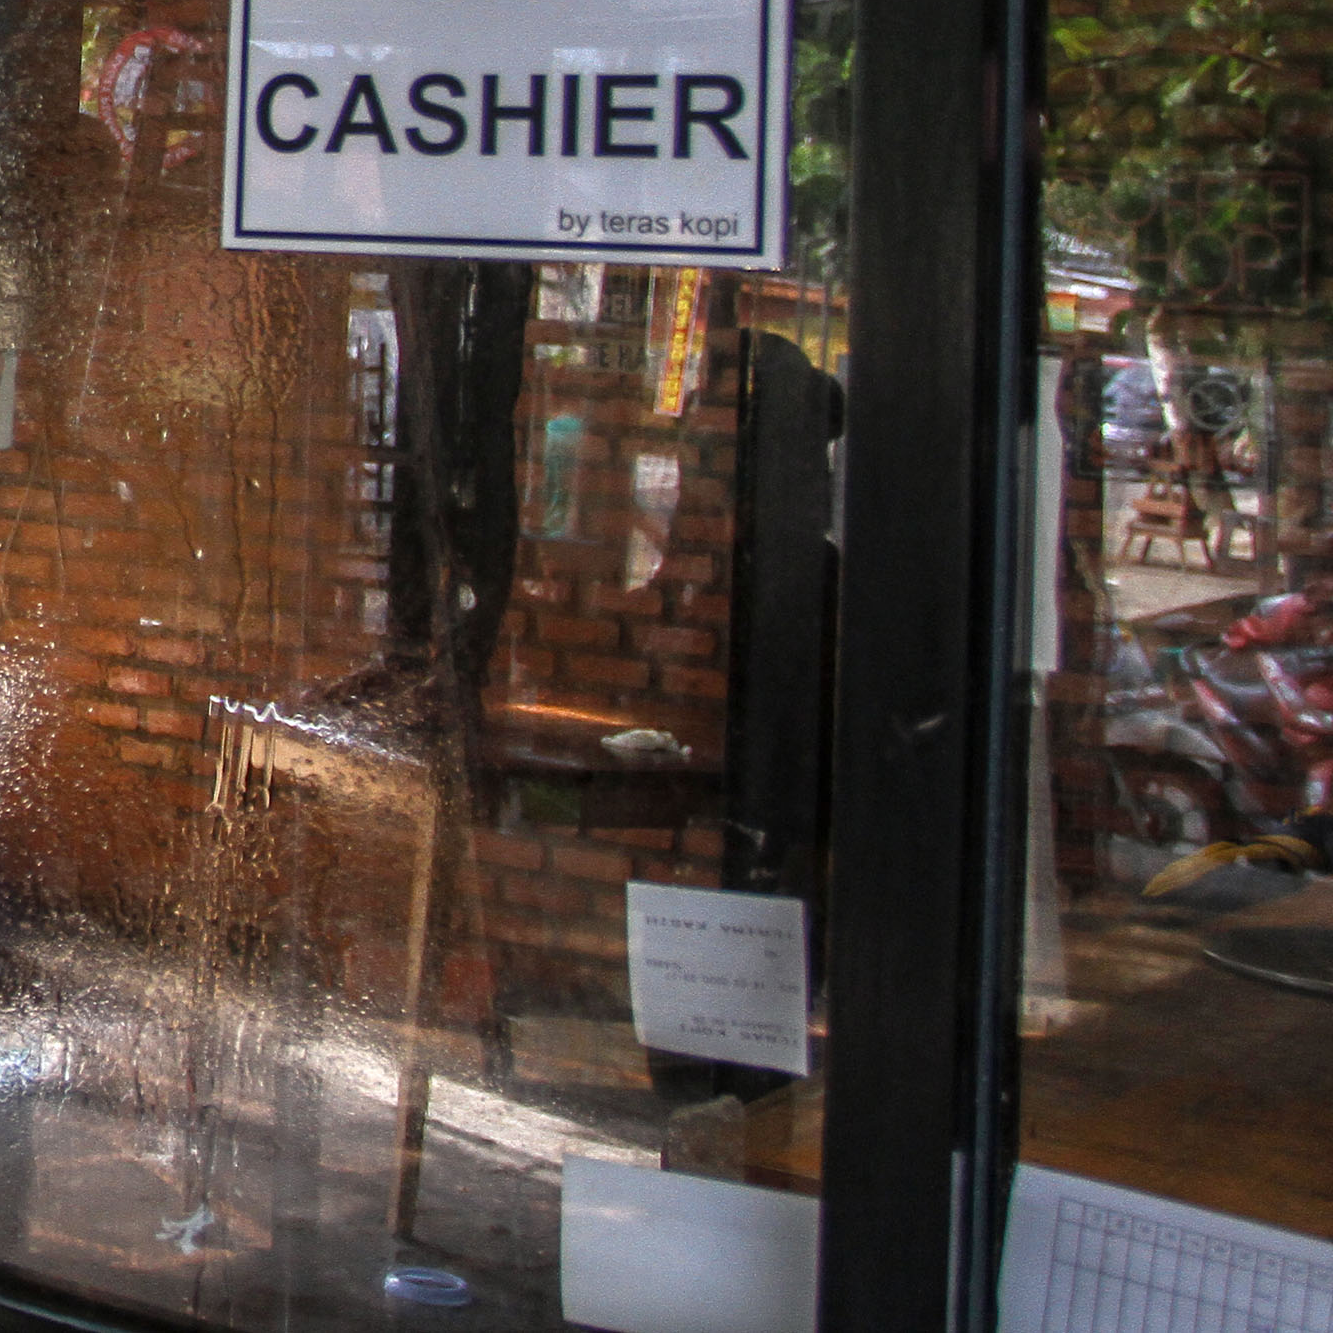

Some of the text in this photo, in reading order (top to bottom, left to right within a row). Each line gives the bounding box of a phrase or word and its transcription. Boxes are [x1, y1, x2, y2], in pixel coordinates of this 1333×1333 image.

[255, 72, 750, 161] CASHIER
[559, 208, 739, 241] by teras kopi
